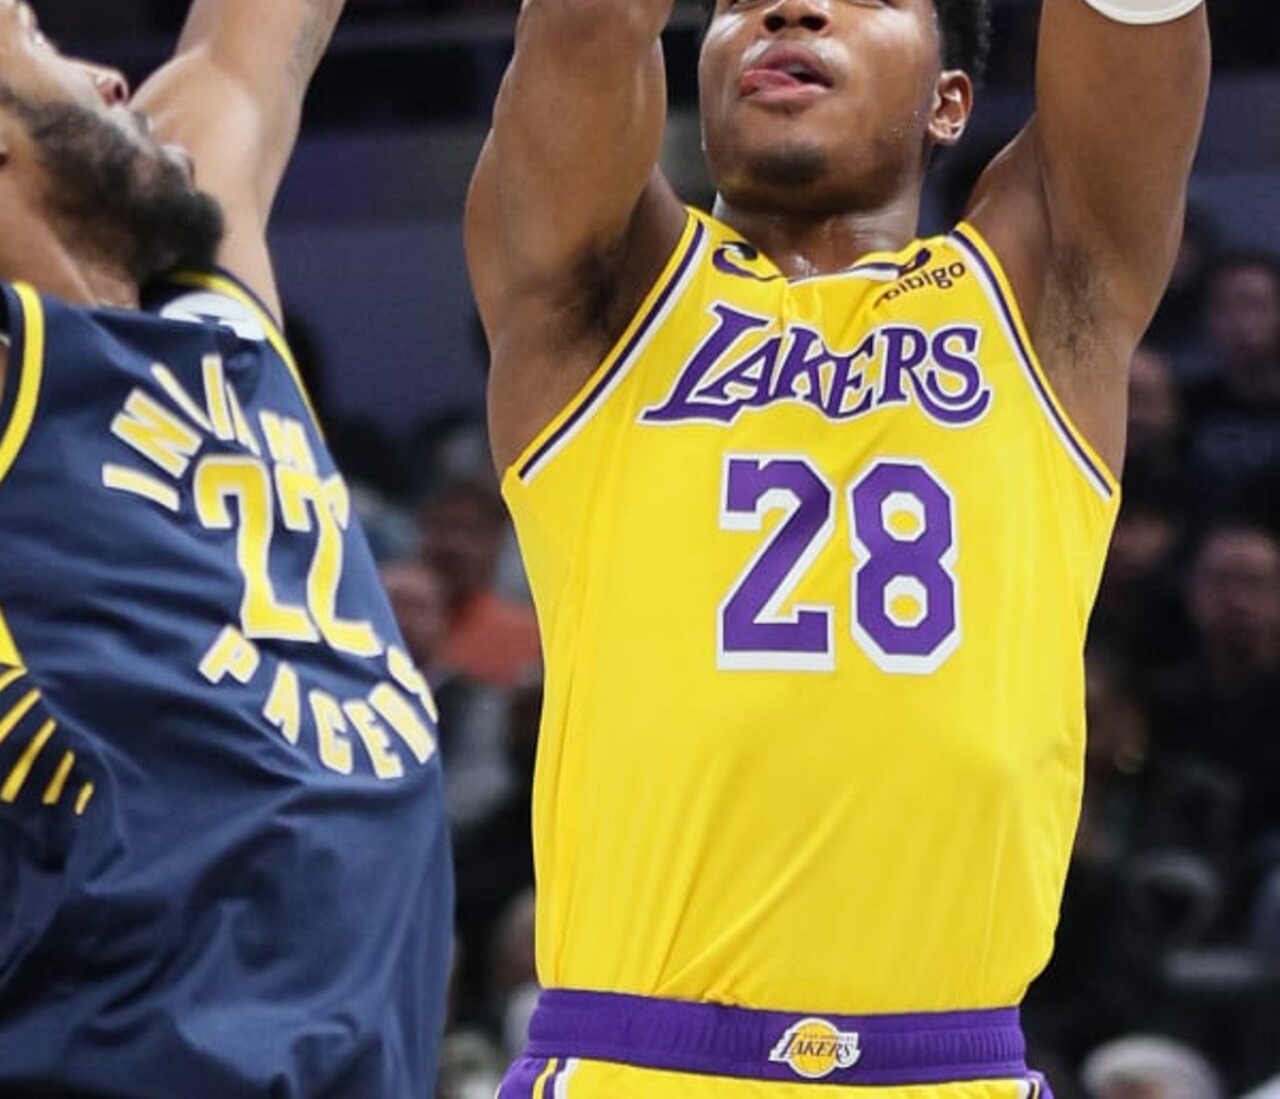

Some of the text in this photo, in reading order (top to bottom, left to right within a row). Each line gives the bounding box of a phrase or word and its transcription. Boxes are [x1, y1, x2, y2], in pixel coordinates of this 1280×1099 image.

[634, 302, 992, 427] LAKERS
[193, 454, 384, 659] 22
[716, 450, 963, 676] 28
